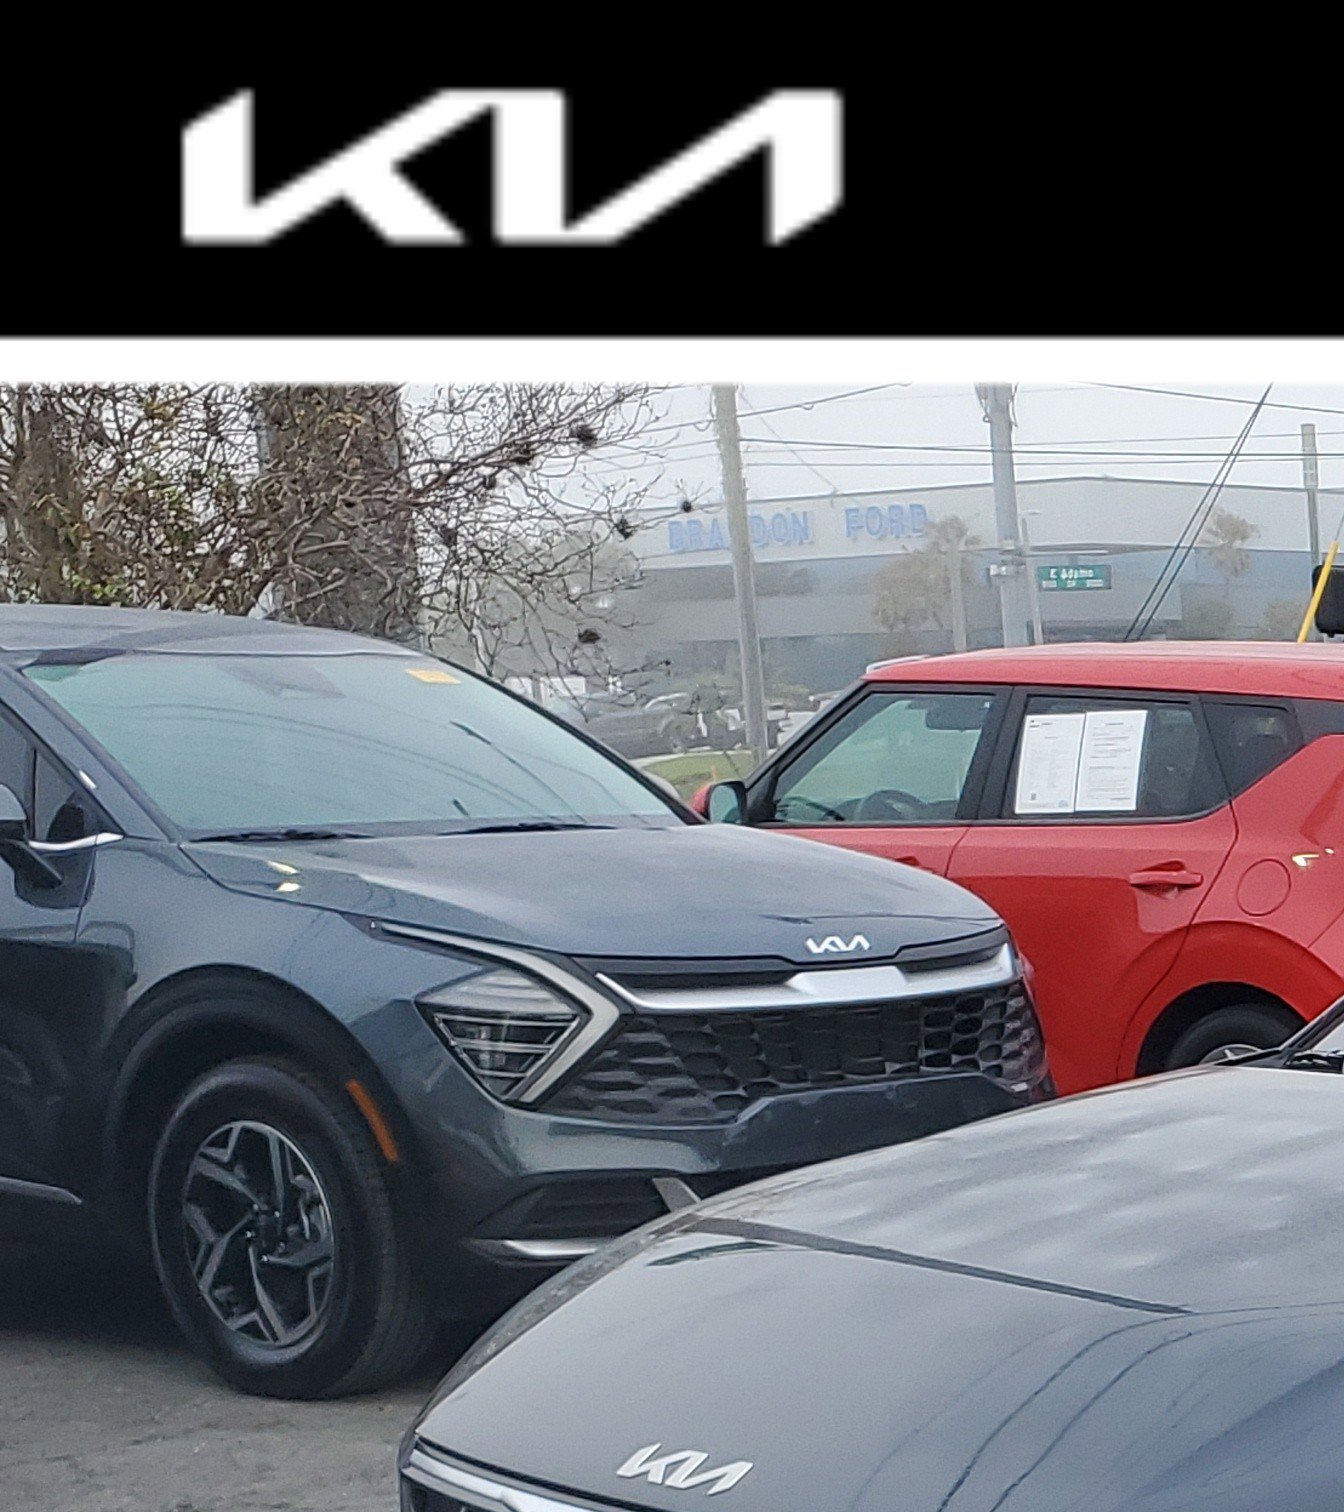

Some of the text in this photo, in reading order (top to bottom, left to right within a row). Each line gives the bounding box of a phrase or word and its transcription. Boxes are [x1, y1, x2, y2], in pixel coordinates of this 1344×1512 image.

[668, 504, 928, 549] BRADON FORD
[805, 934, 871, 954] KIA
[616, 1442, 755, 1496] KIA
